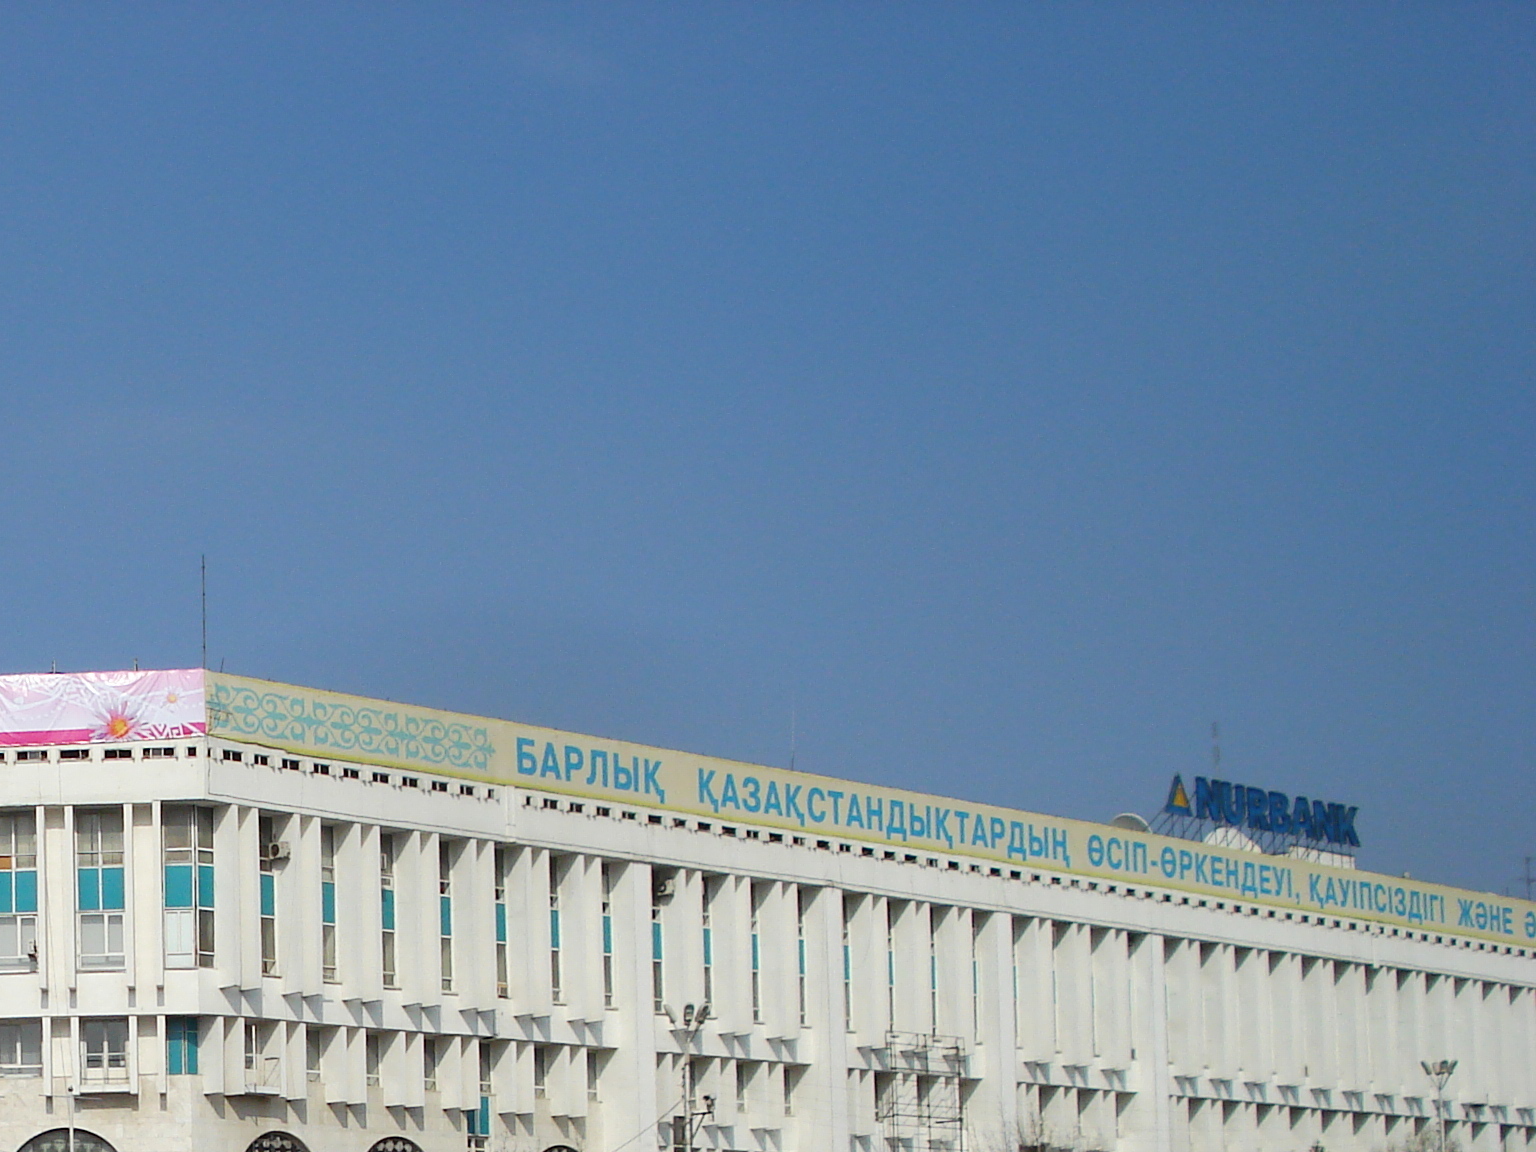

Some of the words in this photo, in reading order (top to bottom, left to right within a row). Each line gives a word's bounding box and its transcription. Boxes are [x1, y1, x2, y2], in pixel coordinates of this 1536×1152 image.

[516, 736, 666, 805] БАРЛЫҚ
[697, 767, 1071, 869] ҚАЗАҚСТАНДЫҚТАРДЫҢ
[1309, 873, 1445, 926] ҚАУІПСІЗДІГІ
[1457, 898, 1514, 936] ЖӘНЕ
[1195, 776, 1361, 847] NURBANK
